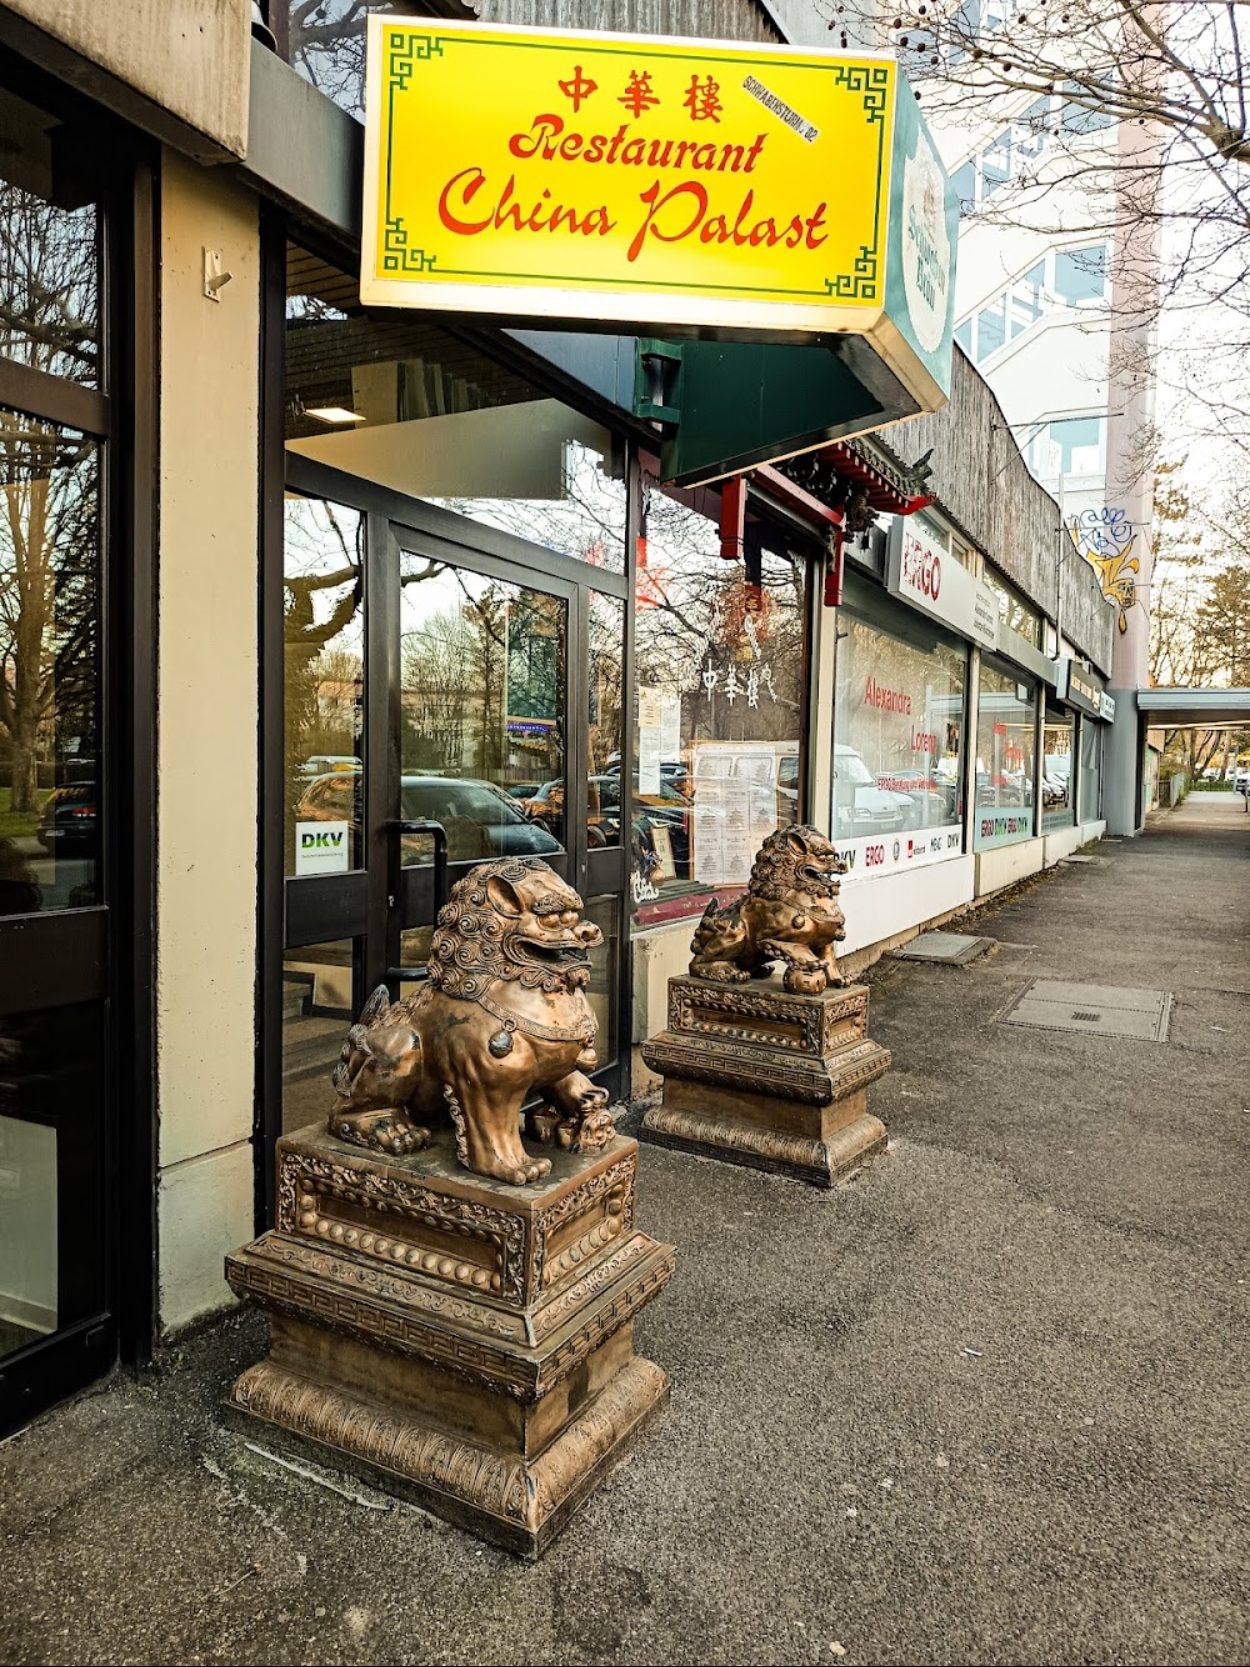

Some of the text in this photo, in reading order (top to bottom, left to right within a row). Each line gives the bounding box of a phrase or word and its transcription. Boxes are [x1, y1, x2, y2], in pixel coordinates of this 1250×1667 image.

[558, 65, 723, 123] 中華樓
[508, 113, 770, 174] Restaurant
[437, 167, 829, 263] China Palast
[904, 533, 941, 602] ERGO
[864, 676, 912, 716] Alexandra
[301, 832, 343, 848] DKV
[865, 844, 885, 866] ERGO
